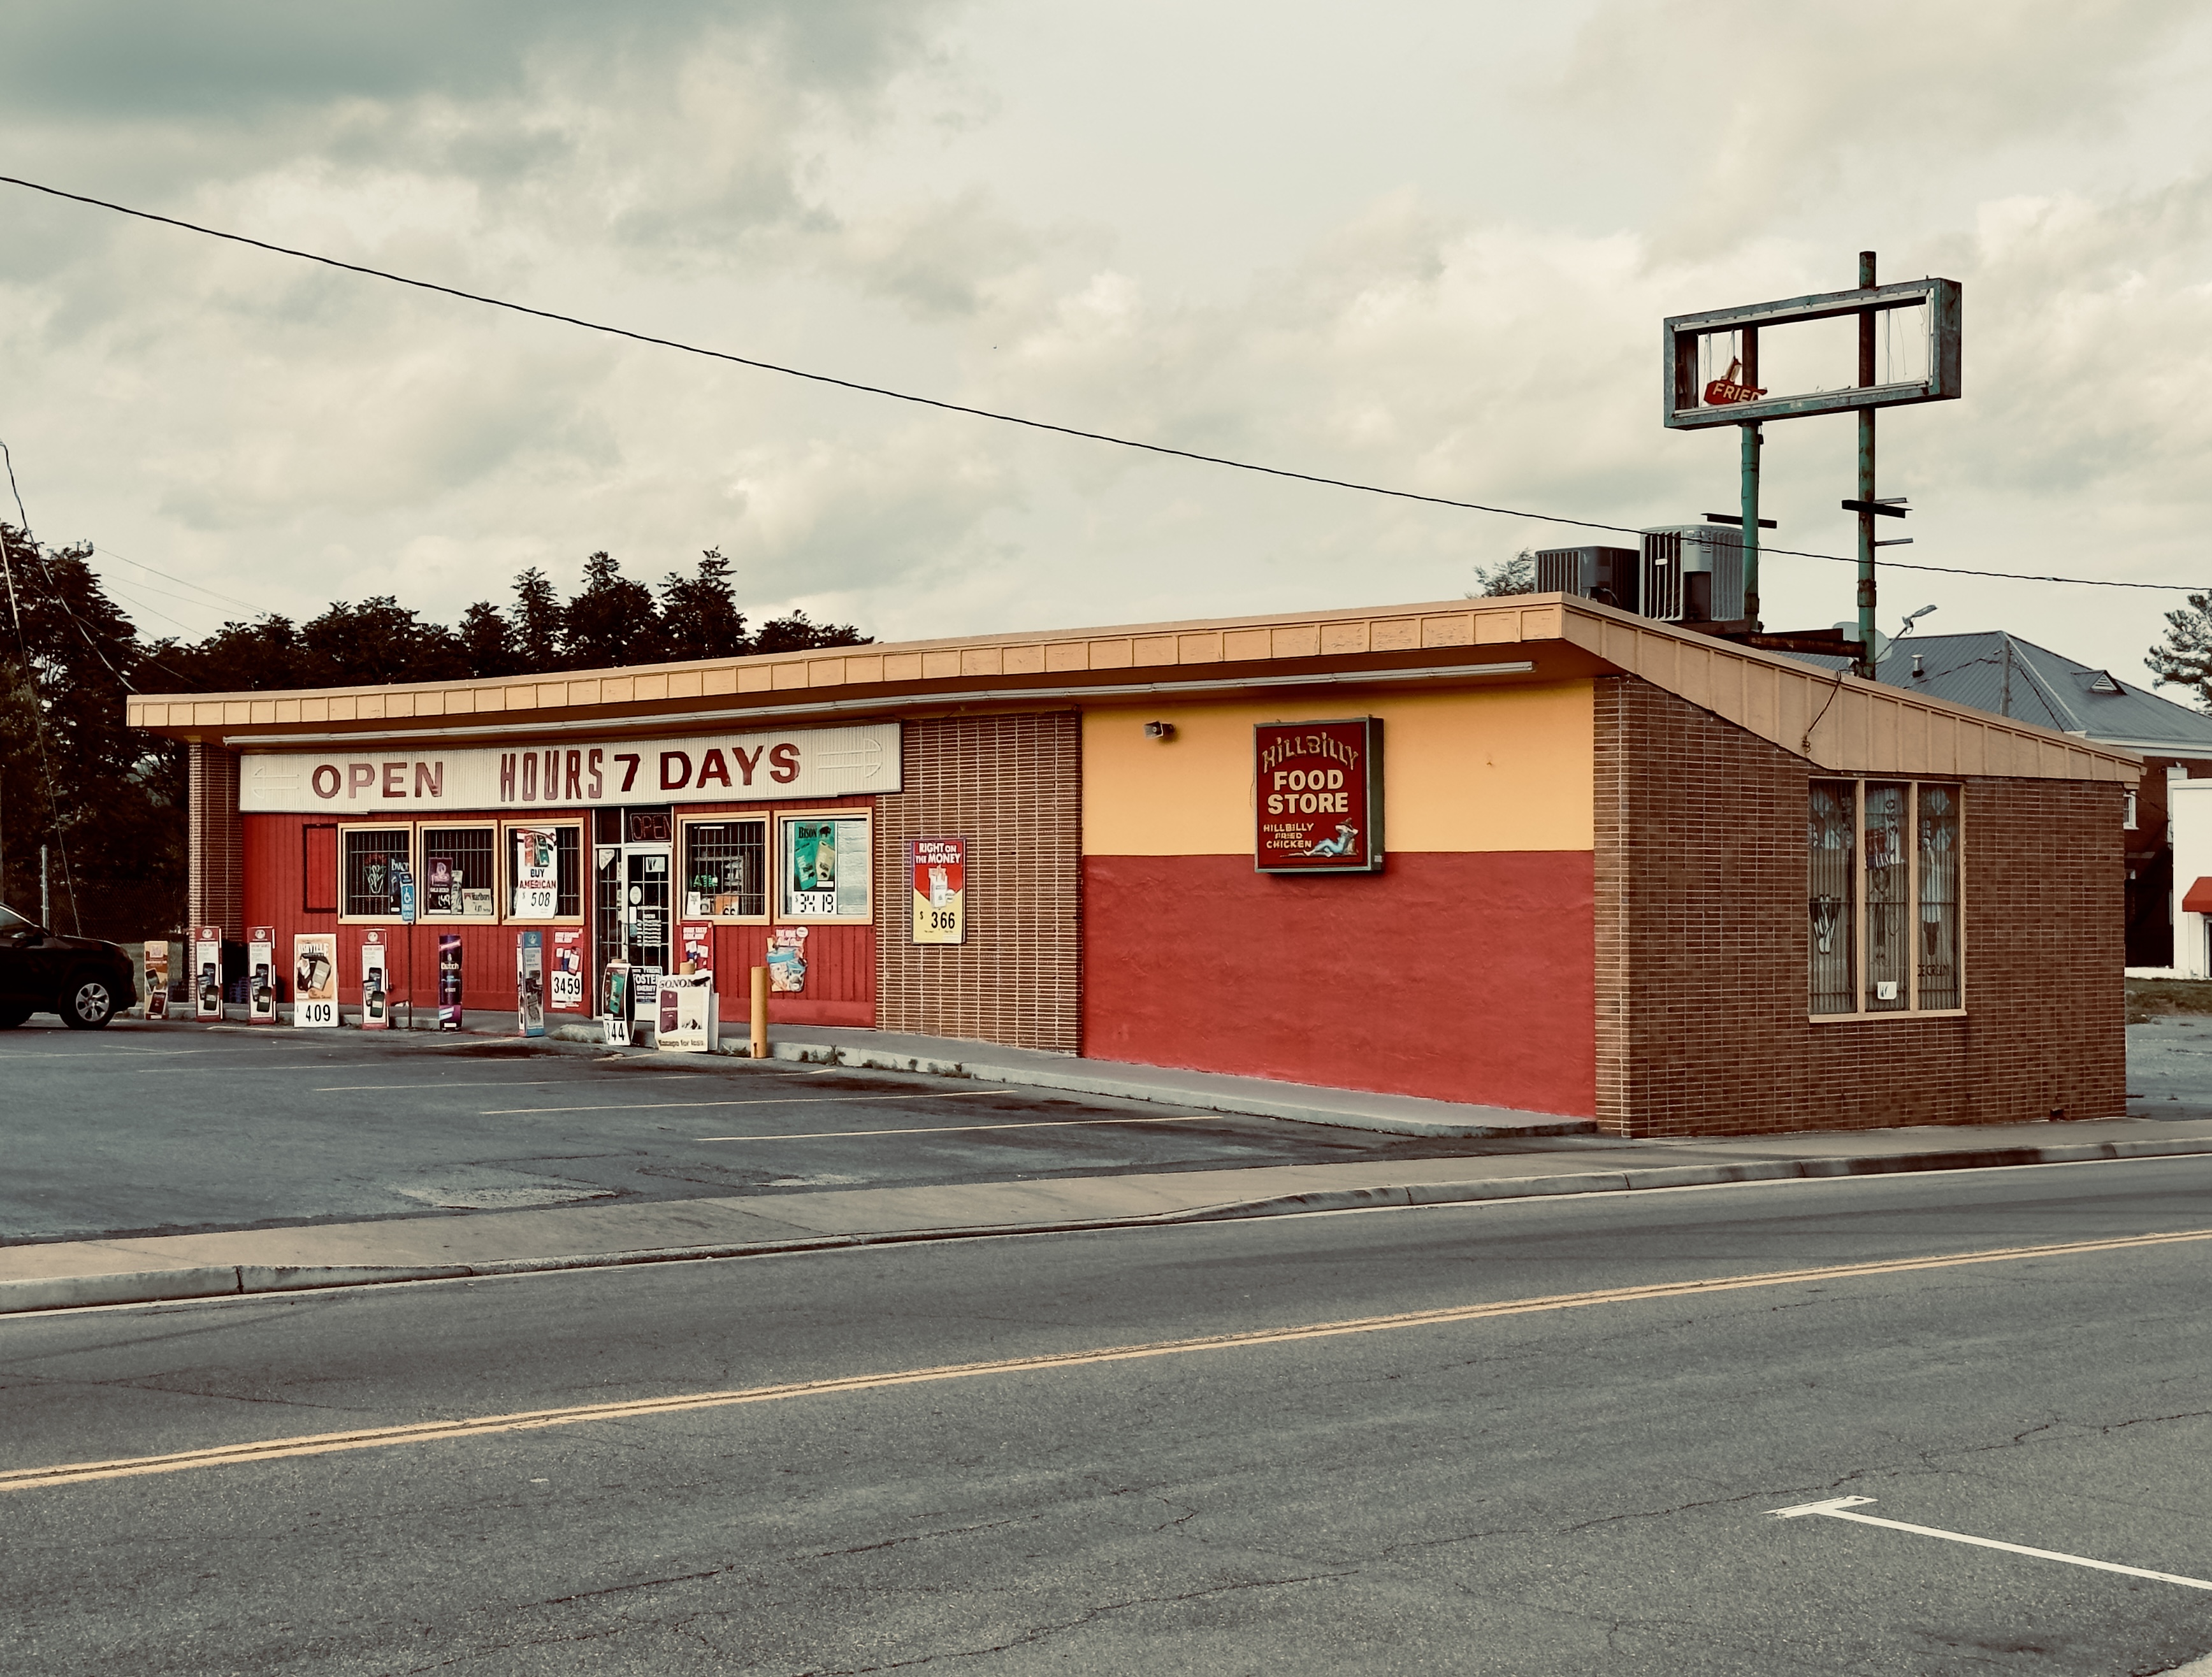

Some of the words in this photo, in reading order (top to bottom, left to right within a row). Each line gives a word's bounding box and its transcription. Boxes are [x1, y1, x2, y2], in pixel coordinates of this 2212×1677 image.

[1712, 382, 1760, 402] FRIED
[312, 761, 444, 799] OPEN
[500, 748, 603, 802] HOURS
[614, 753, 641, 792] 7
[660, 742, 801, 791] DAYS
[1274, 769, 1344, 791] FOOD
[1268, 792, 1348, 815] STORE
[1263, 822, 1314, 833] HILLBILLY
[1275, 831, 1303, 840] FRIED
[919, 842, 945, 853] RIGHT
[945, 844, 957, 853] ON
[1266, 840, 1312, 849] CHICKEN
[915, 854, 927, 865] THE
[928, 853, 961, 865] MONEY
[530, 868, 546, 878] BUY
[519, 879, 556, 889] AMERICAN
[531, 891, 551, 907] 508
[931, 911, 955, 929] 366
